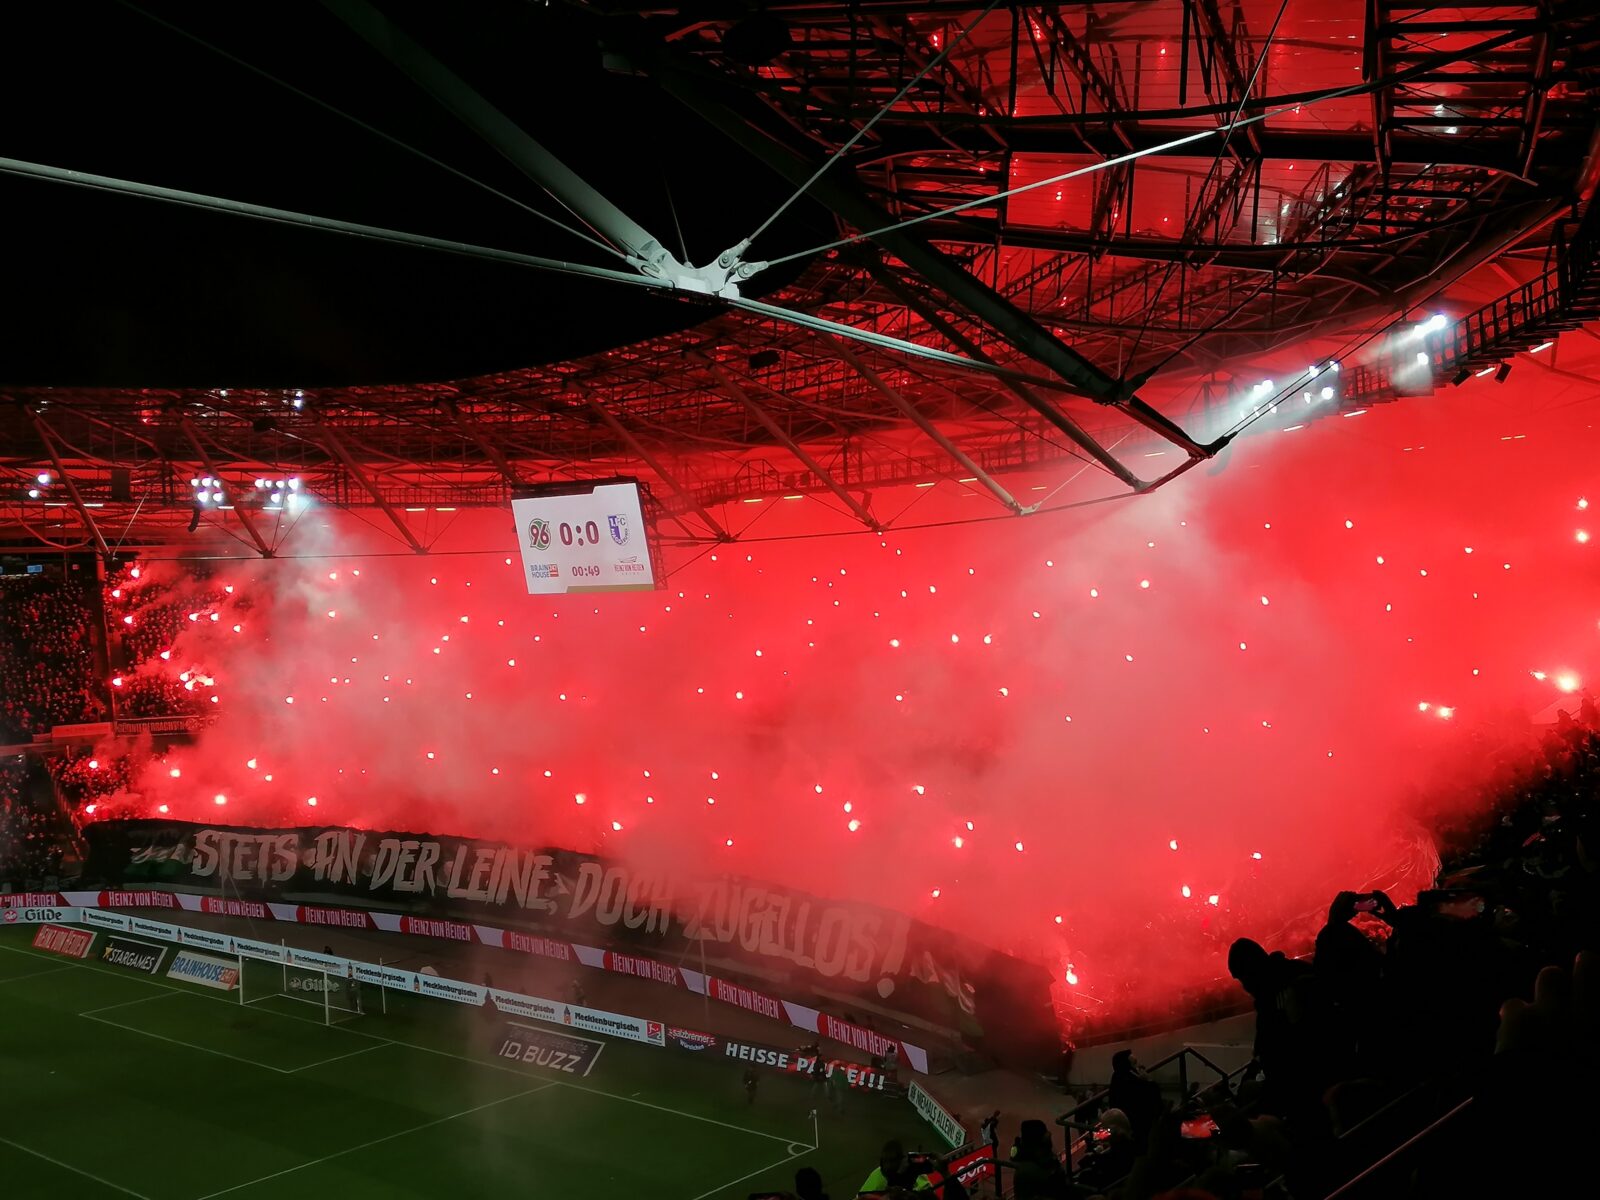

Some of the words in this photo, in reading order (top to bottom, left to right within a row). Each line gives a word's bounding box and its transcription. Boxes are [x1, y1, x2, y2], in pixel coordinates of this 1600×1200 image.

[530, 524, 550, 546] 96
[559, 520, 600, 546] 0:0
[571, 565, 600, 577] 00:49
[191, 828, 300, 881] STETS
[310, 828, 363, 885] AN
[368, 840, 442, 897] DER
[565, 861, 671, 936] DOCH
[26, 892, 57, 907] HEIDEN
[109, 891, 134, 907] HEINZ
[134, 892, 150, 907] VON
[151, 890, 173, 908] HEIDEN
[228, 901, 240, 916] VON
[240, 900, 265, 918] HEIDEN
[25, 908, 62, 921] Gilde
[304, 906, 325, 925] HEINZ
[325, 911, 340, 925] VON
[340, 909, 367, 928] HEIDEN
[408, 917, 429, 936] HEINZ
[429, 921, 444, 937] VON
[444, 920, 471, 941] HEIDEN
[510, 931, 530, 953] HEINZ
[530, 936, 543, 956] VON
[543, 937, 570, 961] HEIDEN
[108, 948, 156, 970] STARGAMES
[171, 956, 224, 981] BRAINHOUSE
[612, 951, 635, 976] HEINZ
[635, 958, 651, 978] VON
[651, 959, 678, 986] HEIDEN
[422, 980, 478, 998] Mecklenburgische
[717, 978, 738, 1006] HEINZ
[738, 988, 752, 1010] VON
[752, 990, 779, 1020] HEIDEN
[495, 995, 555, 1014] Mecklenburgische
[574, 1011, 640, 1033] Mecklenburgische
[827, 1015, 851, 1045] HEINZ
[851, 1026, 868, 1052] VON
[725, 1042, 789, 1069] HEISSE
